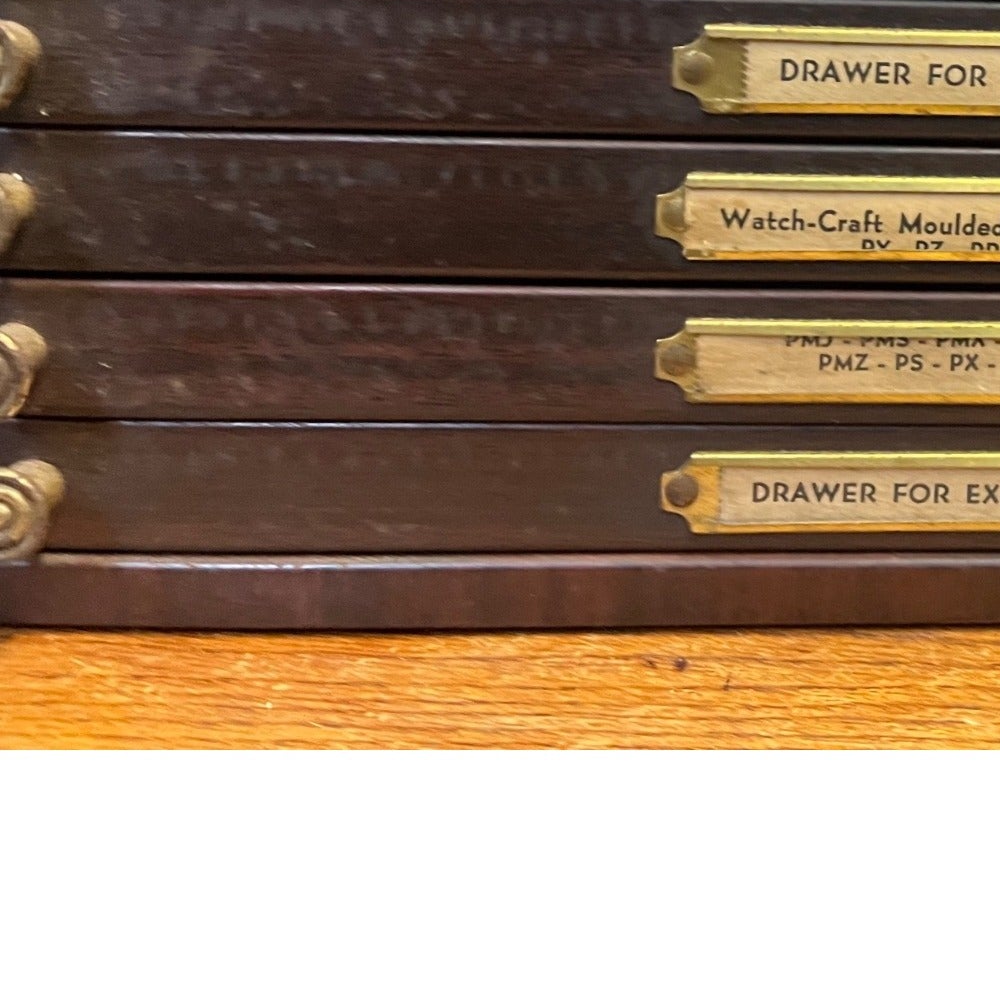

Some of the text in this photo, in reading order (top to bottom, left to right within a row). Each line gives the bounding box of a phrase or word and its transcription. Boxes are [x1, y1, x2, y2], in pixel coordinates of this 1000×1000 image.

[780, 58, 911, 86] DRAWER
[927, 63, 987, 88] FOR
[720, 207, 884, 234] Watch-Craft
[818, 353, 869, 372] PMZ
[895, 352, 924, 372] PS
[950, 353, 979, 372] PX
[752, 481, 877, 503] DRAWER
[892, 482, 950, 504] FOR
